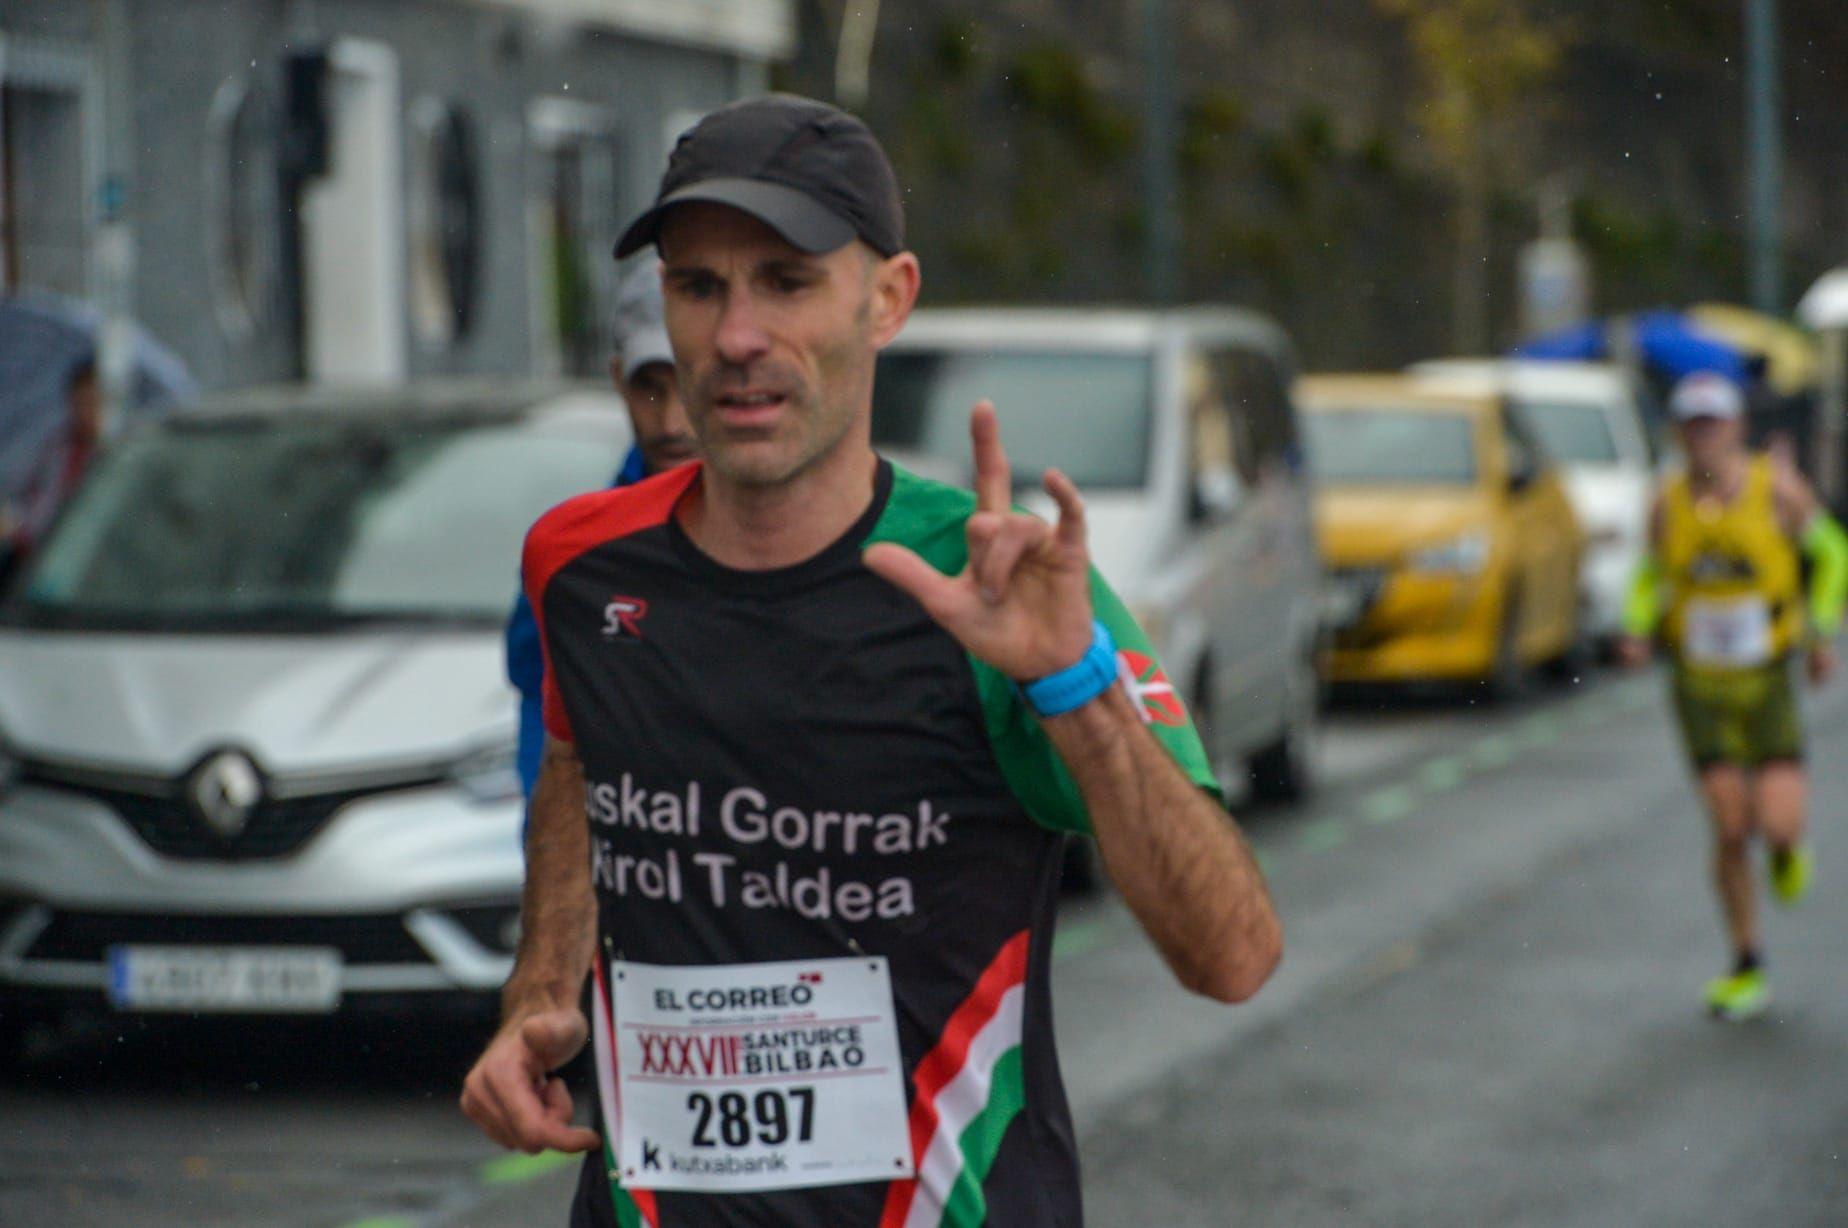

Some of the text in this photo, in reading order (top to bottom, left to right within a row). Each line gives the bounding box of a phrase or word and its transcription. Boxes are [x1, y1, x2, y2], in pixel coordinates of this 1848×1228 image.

[720, 786, 950, 855] Gorrak
[693, 853, 915, 921] Taldea
[654, 984, 813, 1011] EL CORREO
[742, 1025, 861, 1050] SANTURCE
[744, 1047, 864, 1075] BILBAO
[687, 1086, 815, 1148] 2897
[668, 1150, 788, 1176] kutxabank
